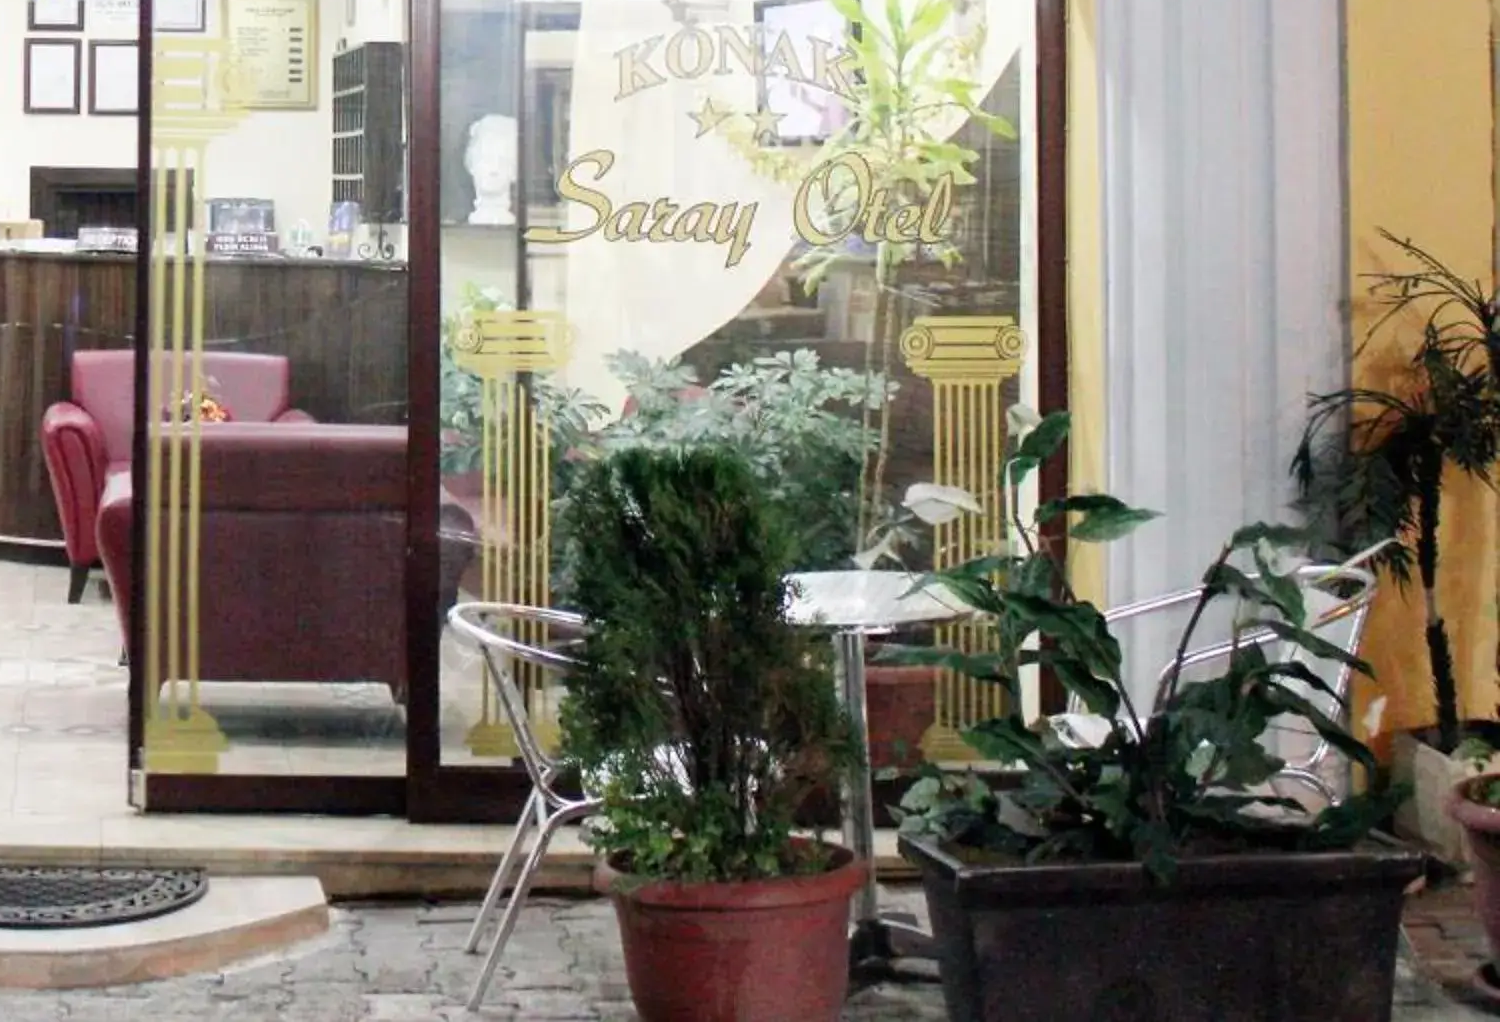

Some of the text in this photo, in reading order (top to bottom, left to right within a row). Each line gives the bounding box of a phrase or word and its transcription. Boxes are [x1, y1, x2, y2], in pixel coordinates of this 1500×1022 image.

[613, 25, 861, 103] KONAK
[523, 149, 953, 269] Saray Otel
